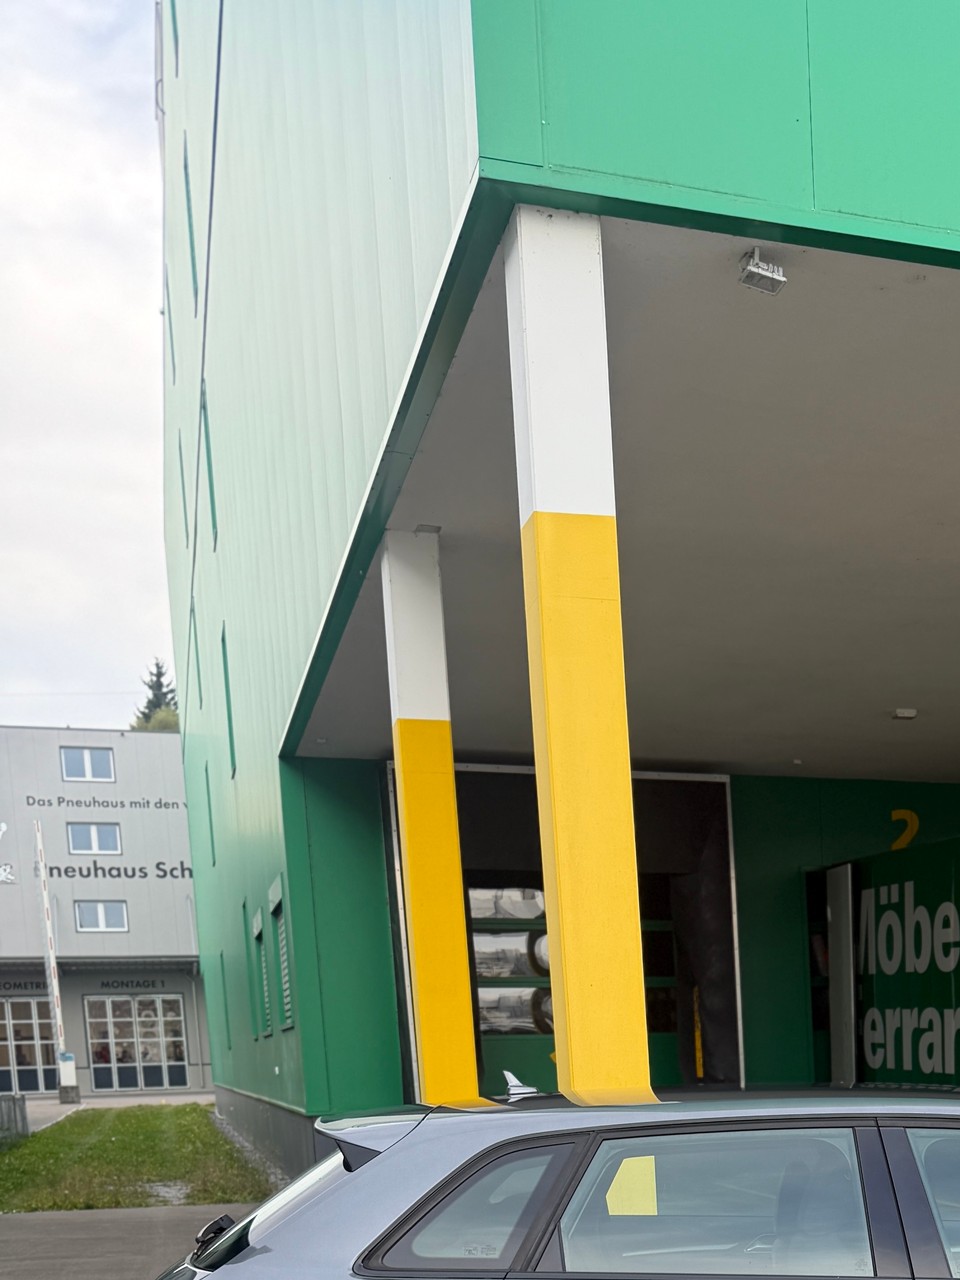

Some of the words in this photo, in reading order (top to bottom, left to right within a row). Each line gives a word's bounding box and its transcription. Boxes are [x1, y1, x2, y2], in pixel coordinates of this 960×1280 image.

[26, 795, 53, 807] Das
[57, 796, 126, 808] Pneuhaus
[129, 797, 151, 809] mit
[154, 798, 179, 810] den
[101, 980, 157, 989] MONTAGE
[160, 979, 165, 988] 1
